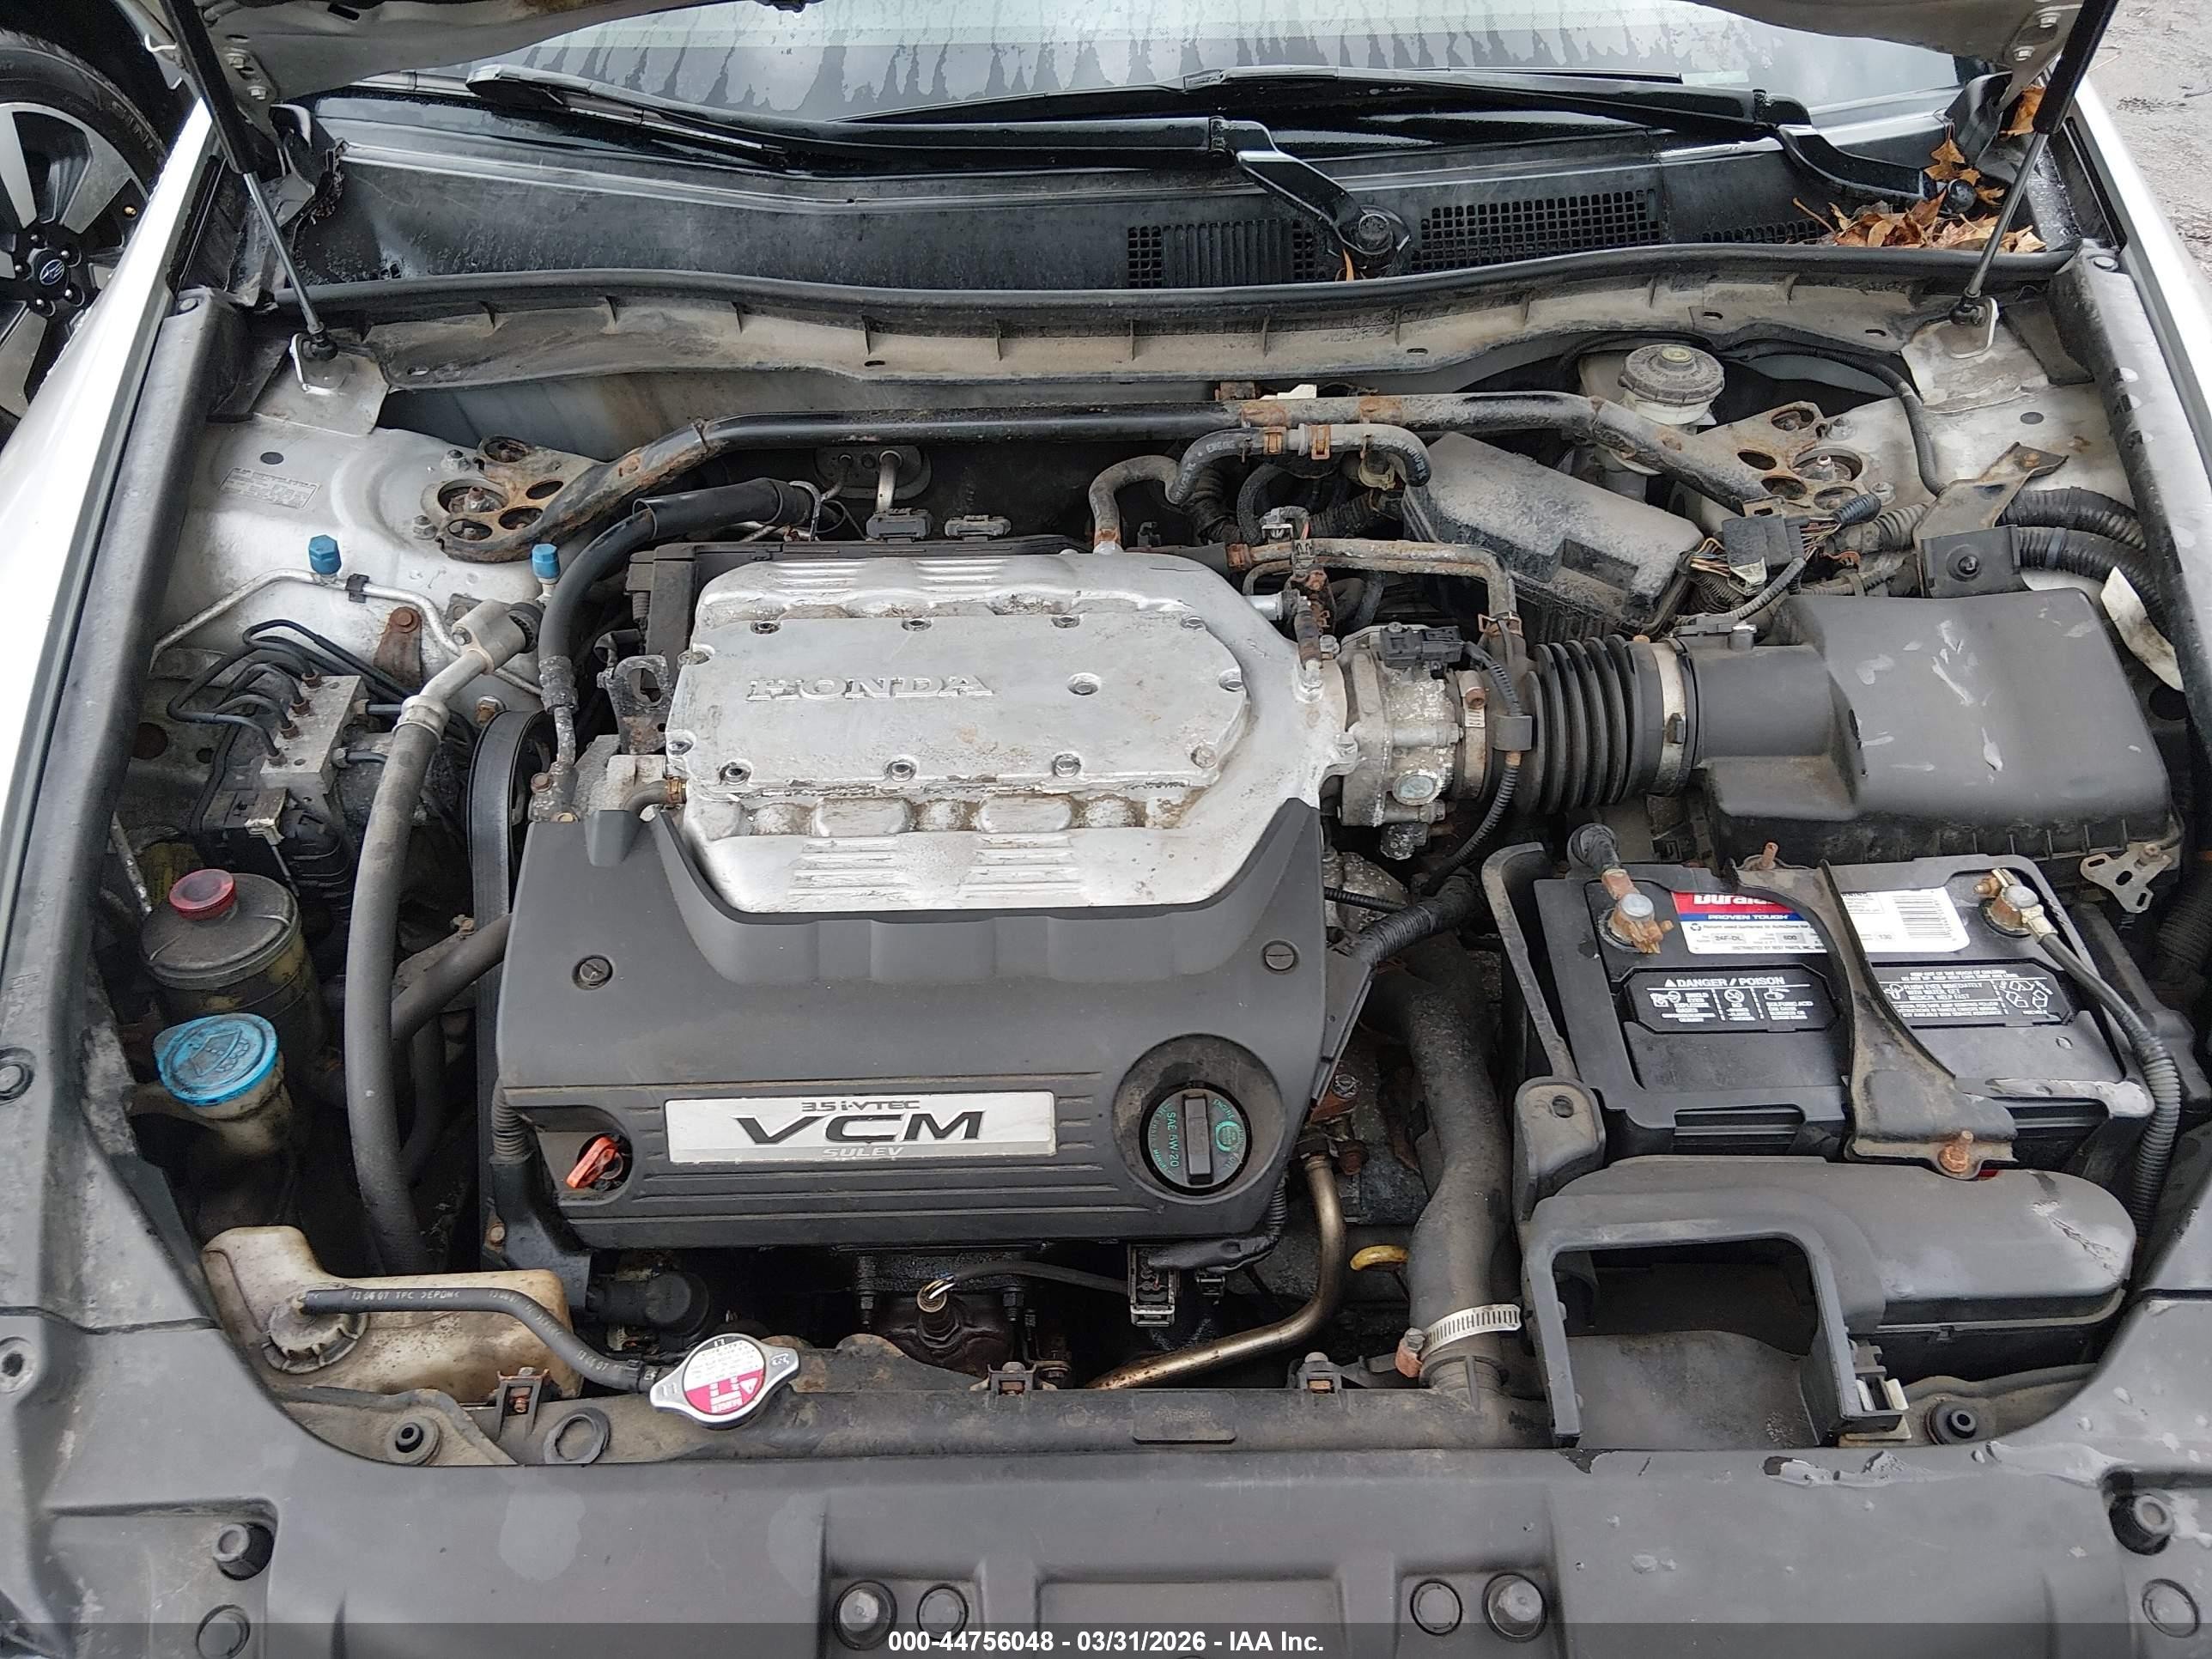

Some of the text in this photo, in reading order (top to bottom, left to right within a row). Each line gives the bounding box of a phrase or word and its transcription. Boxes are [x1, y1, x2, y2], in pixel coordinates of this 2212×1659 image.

[745, 675, 994, 702] HONDA
[1676, 978, 1728, 988] DANGER
[1739, 976, 1785, 987] POISON
[841, 1100, 921, 1111] i-VTEC
[731, 1110, 986, 1146] VCM
[1167, 1112, 1180, 1168] SAE 5W-20
[821, 1146, 904, 1158] SULEV
